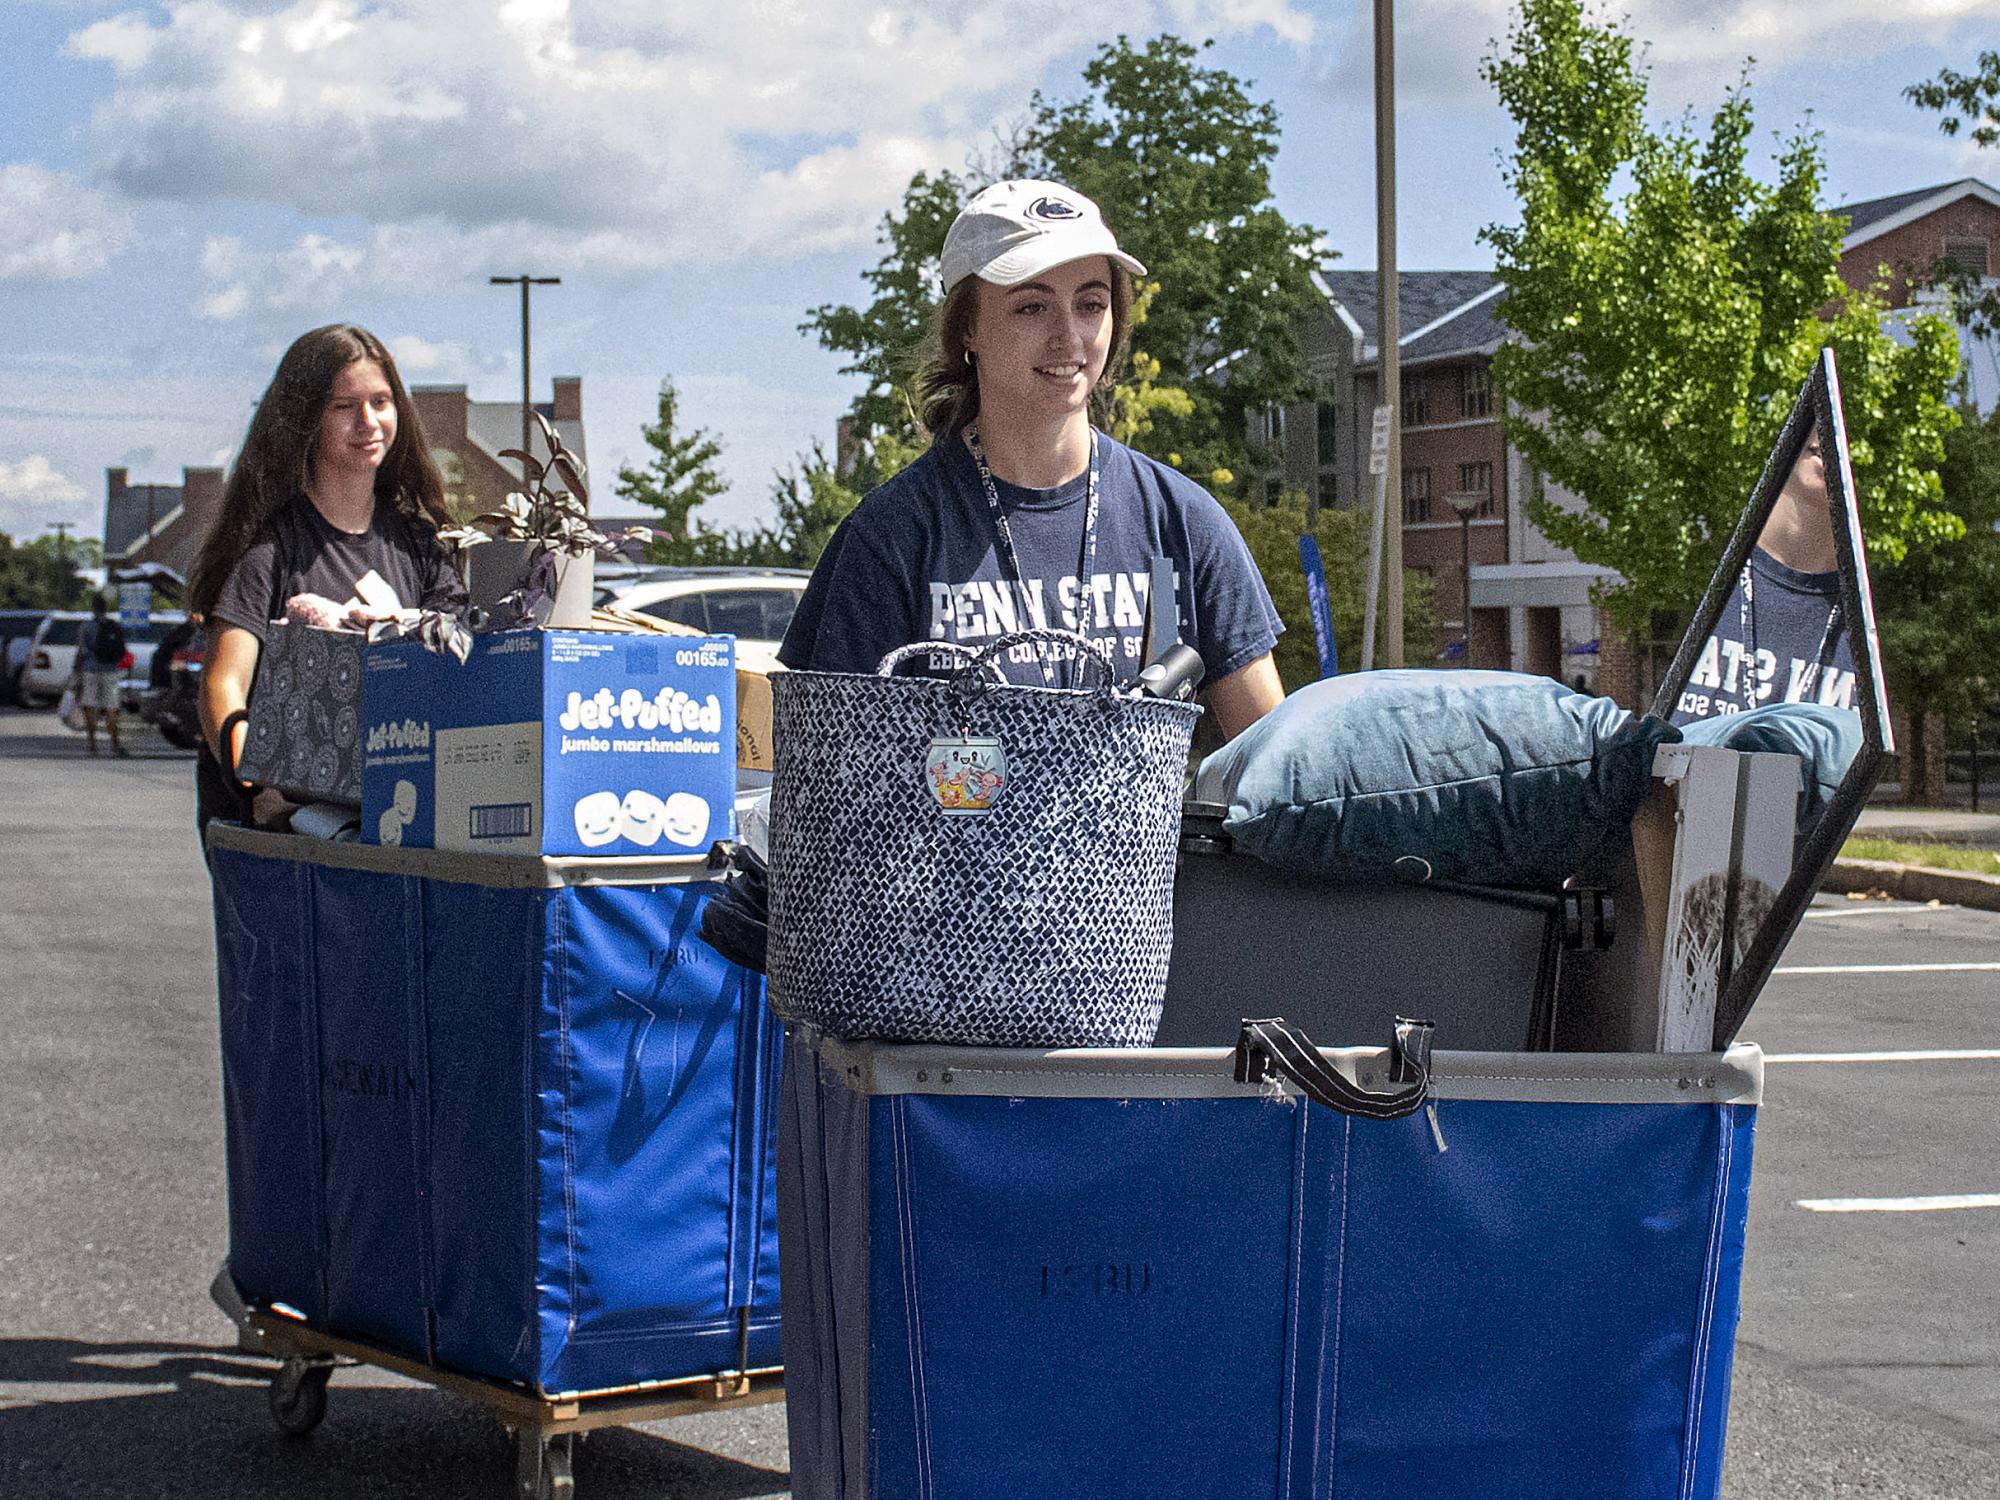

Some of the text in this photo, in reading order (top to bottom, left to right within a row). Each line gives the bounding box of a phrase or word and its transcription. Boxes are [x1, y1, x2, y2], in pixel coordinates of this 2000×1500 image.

[929, 578, 1048, 639] PENN
[1058, 571, 1181, 630] STAT
[559, 687, 721, 734] Jet-Puffed
[560, 735, 611, 754] jumbo
[612, 737, 720, 754] marshmallows
[737, 721, 761, 761] onal
